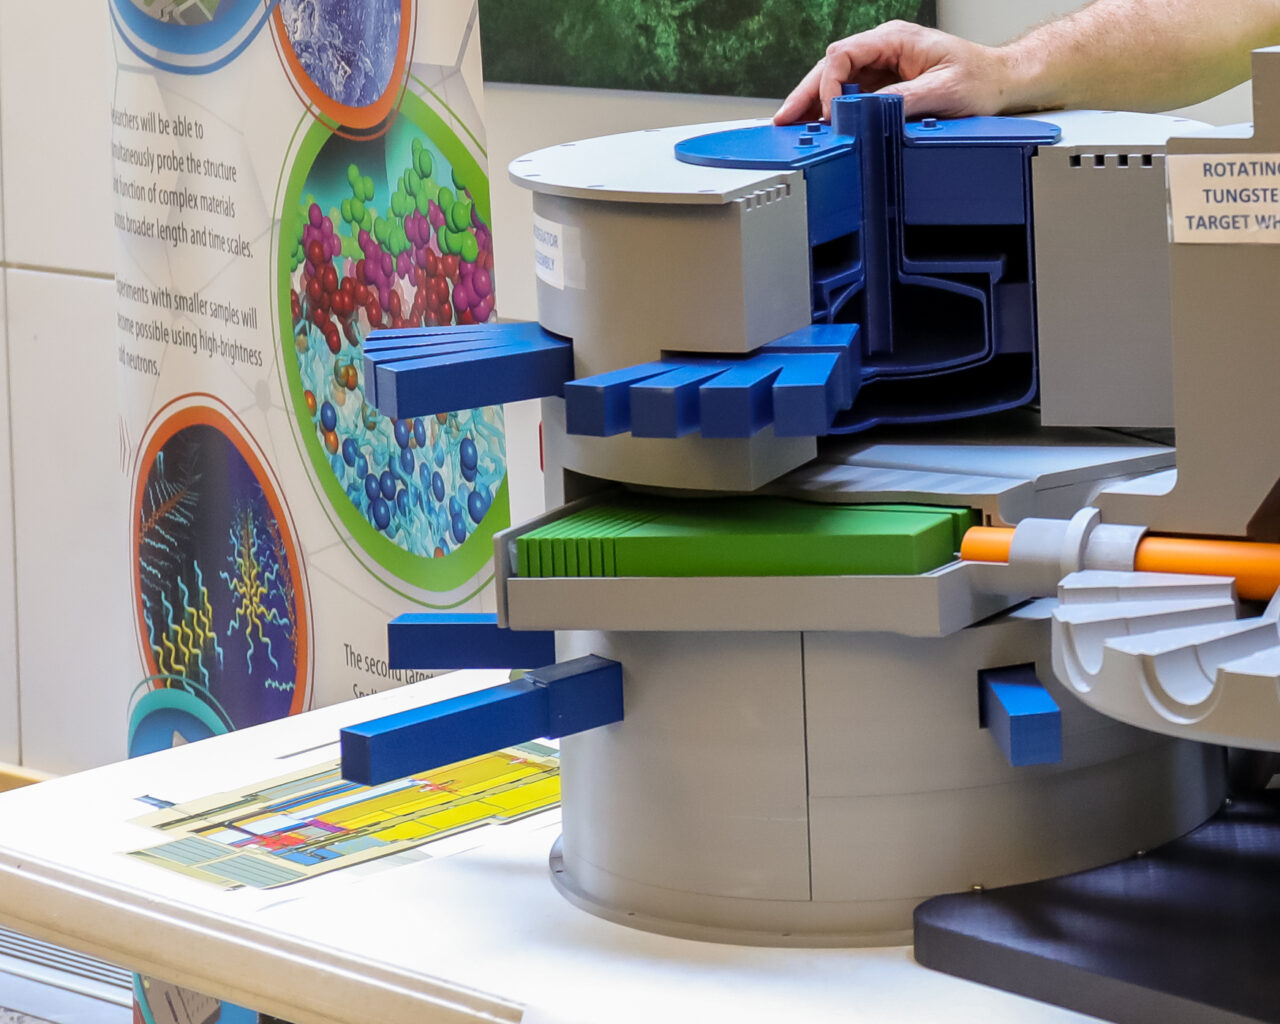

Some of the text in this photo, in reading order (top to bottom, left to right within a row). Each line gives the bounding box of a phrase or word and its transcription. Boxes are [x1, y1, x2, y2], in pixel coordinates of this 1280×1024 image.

[140, 112, 157, 134] will
[158, 113, 170, 135] be
[172, 114, 193, 139] able
[194, 120, 204, 140] to
[156, 149, 184, 174] probe
[186, 152, 202, 176] the
[203, 158, 237, 183] structure
[148, 182, 157, 203] of
[159, 187, 198, 212] complex
[200, 195, 236, 218] materials
[126, 213, 155, 239] broader
[156, 218, 188, 248] length
[190, 224, 207, 247] and
[208, 228, 225, 253] time
[227, 234, 254, 258] scales.
[1185, 214, 1250, 230] TARGET
[150, 287, 172, 310] with
[173, 292, 208, 315] smaller
[209, 301, 240, 328] samples
[241, 307, 258, 329] will
[135, 320, 170, 345] possible
[171, 326, 198, 355] using
[199, 328, 263, 368] high-brightness
[126, 351, 161, 376] neutrons.
[343, 642, 363, 670] The
